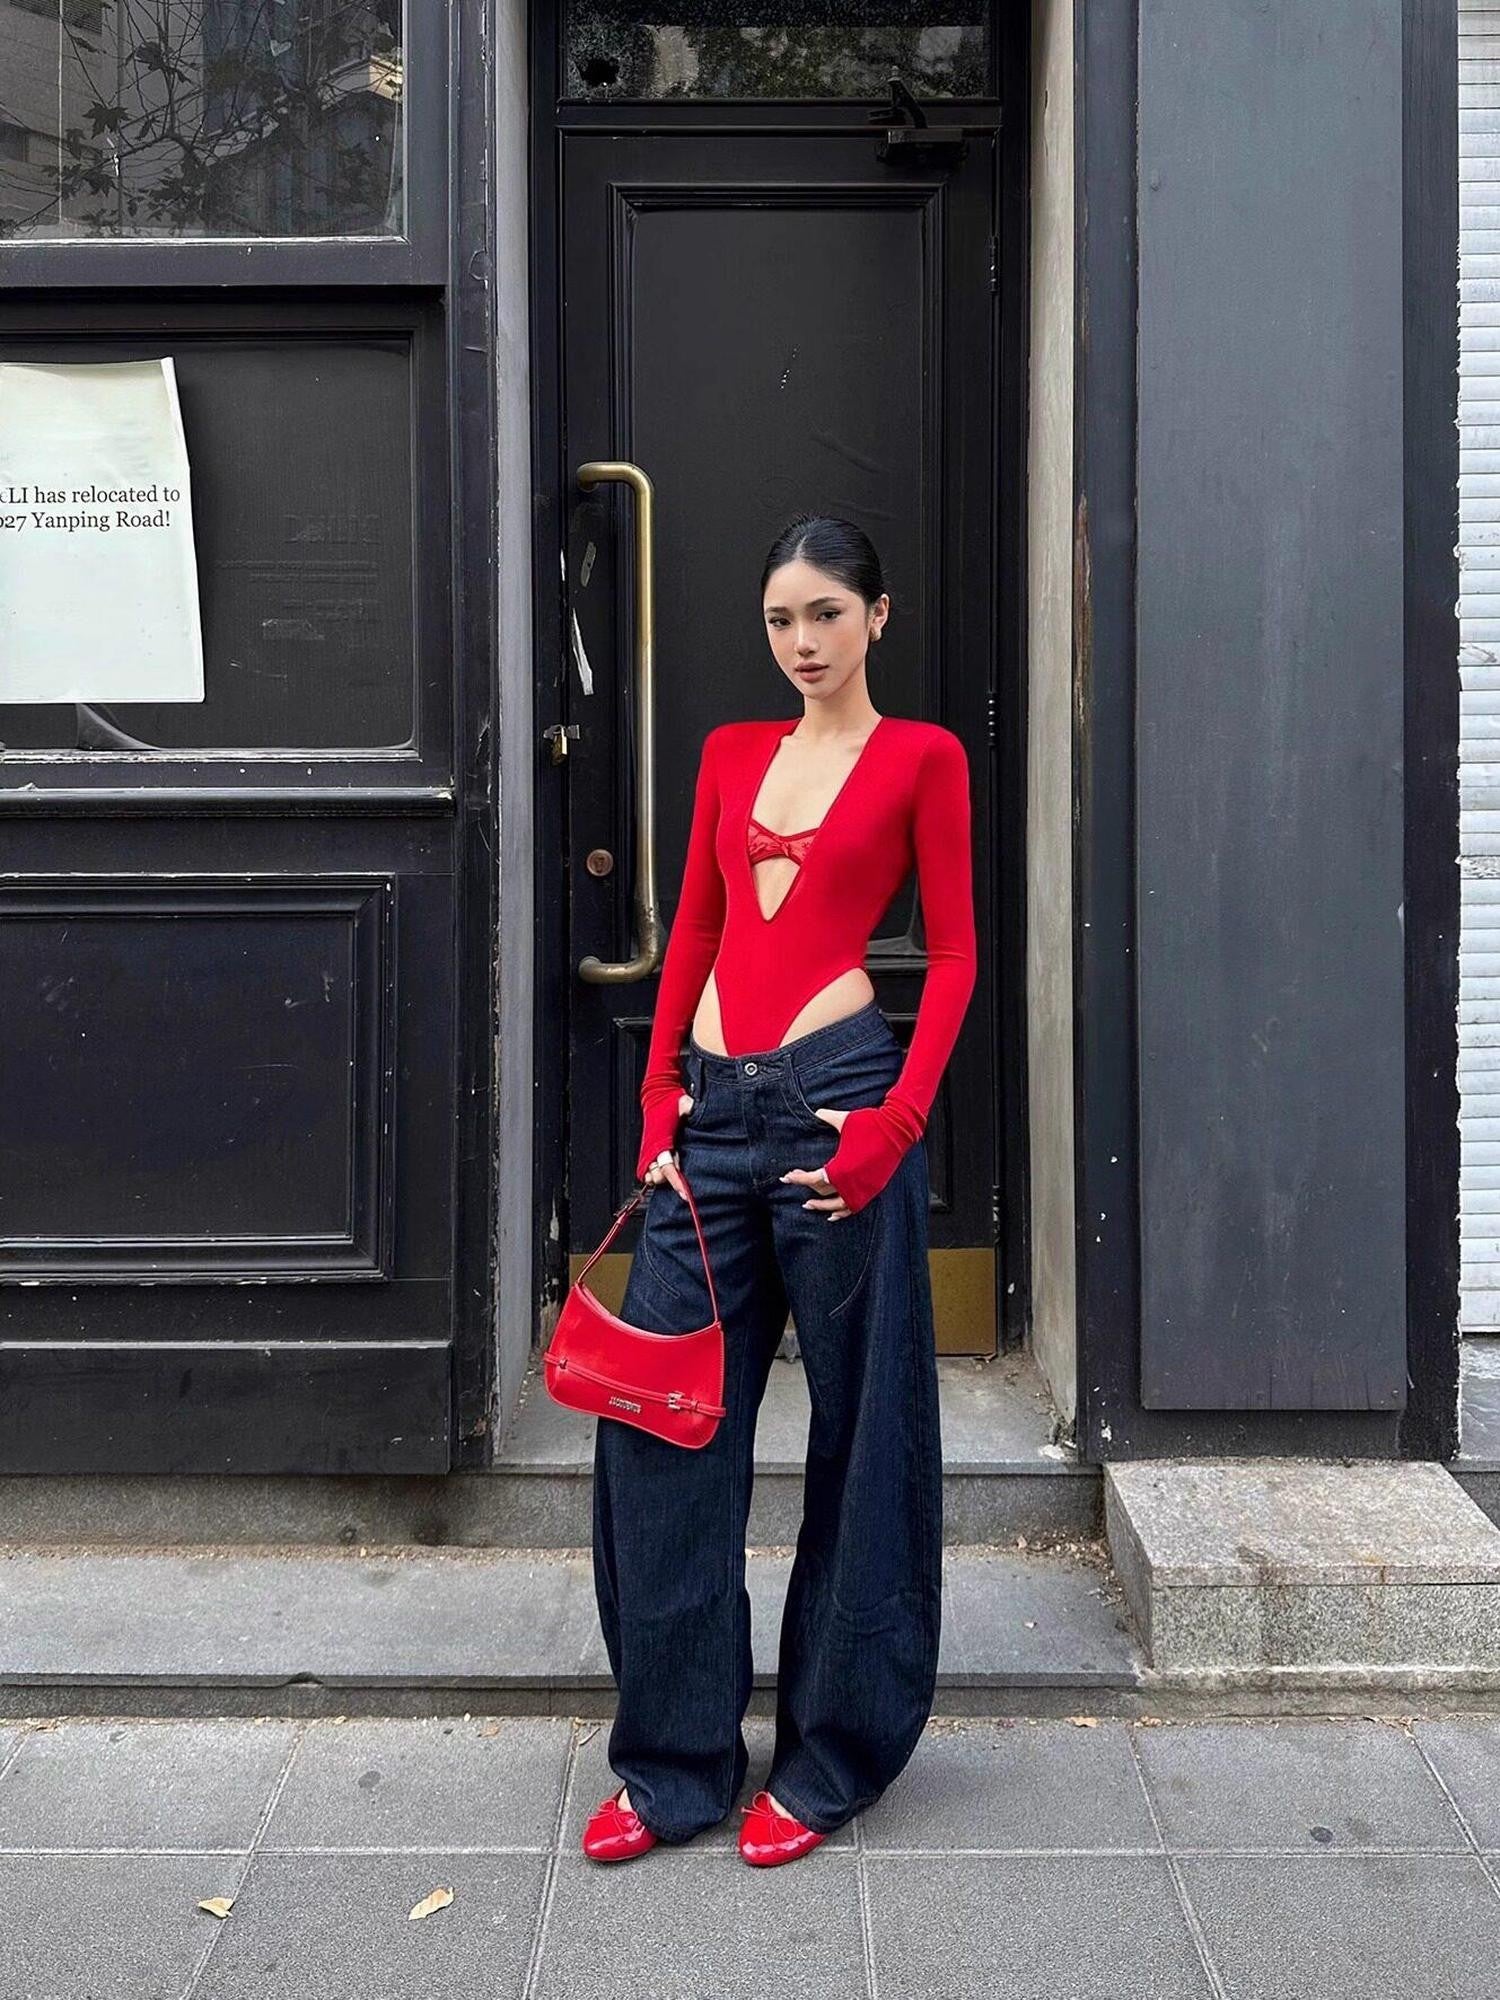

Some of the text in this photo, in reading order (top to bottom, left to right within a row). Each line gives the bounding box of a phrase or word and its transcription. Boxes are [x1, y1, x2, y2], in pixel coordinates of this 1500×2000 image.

[34, 485, 66, 504] has
[71, 485, 158, 503] relocated
[163, 488, 181, 502] to
[31, 511, 110, 532] Yanping
[116, 510, 171, 528] Road!
